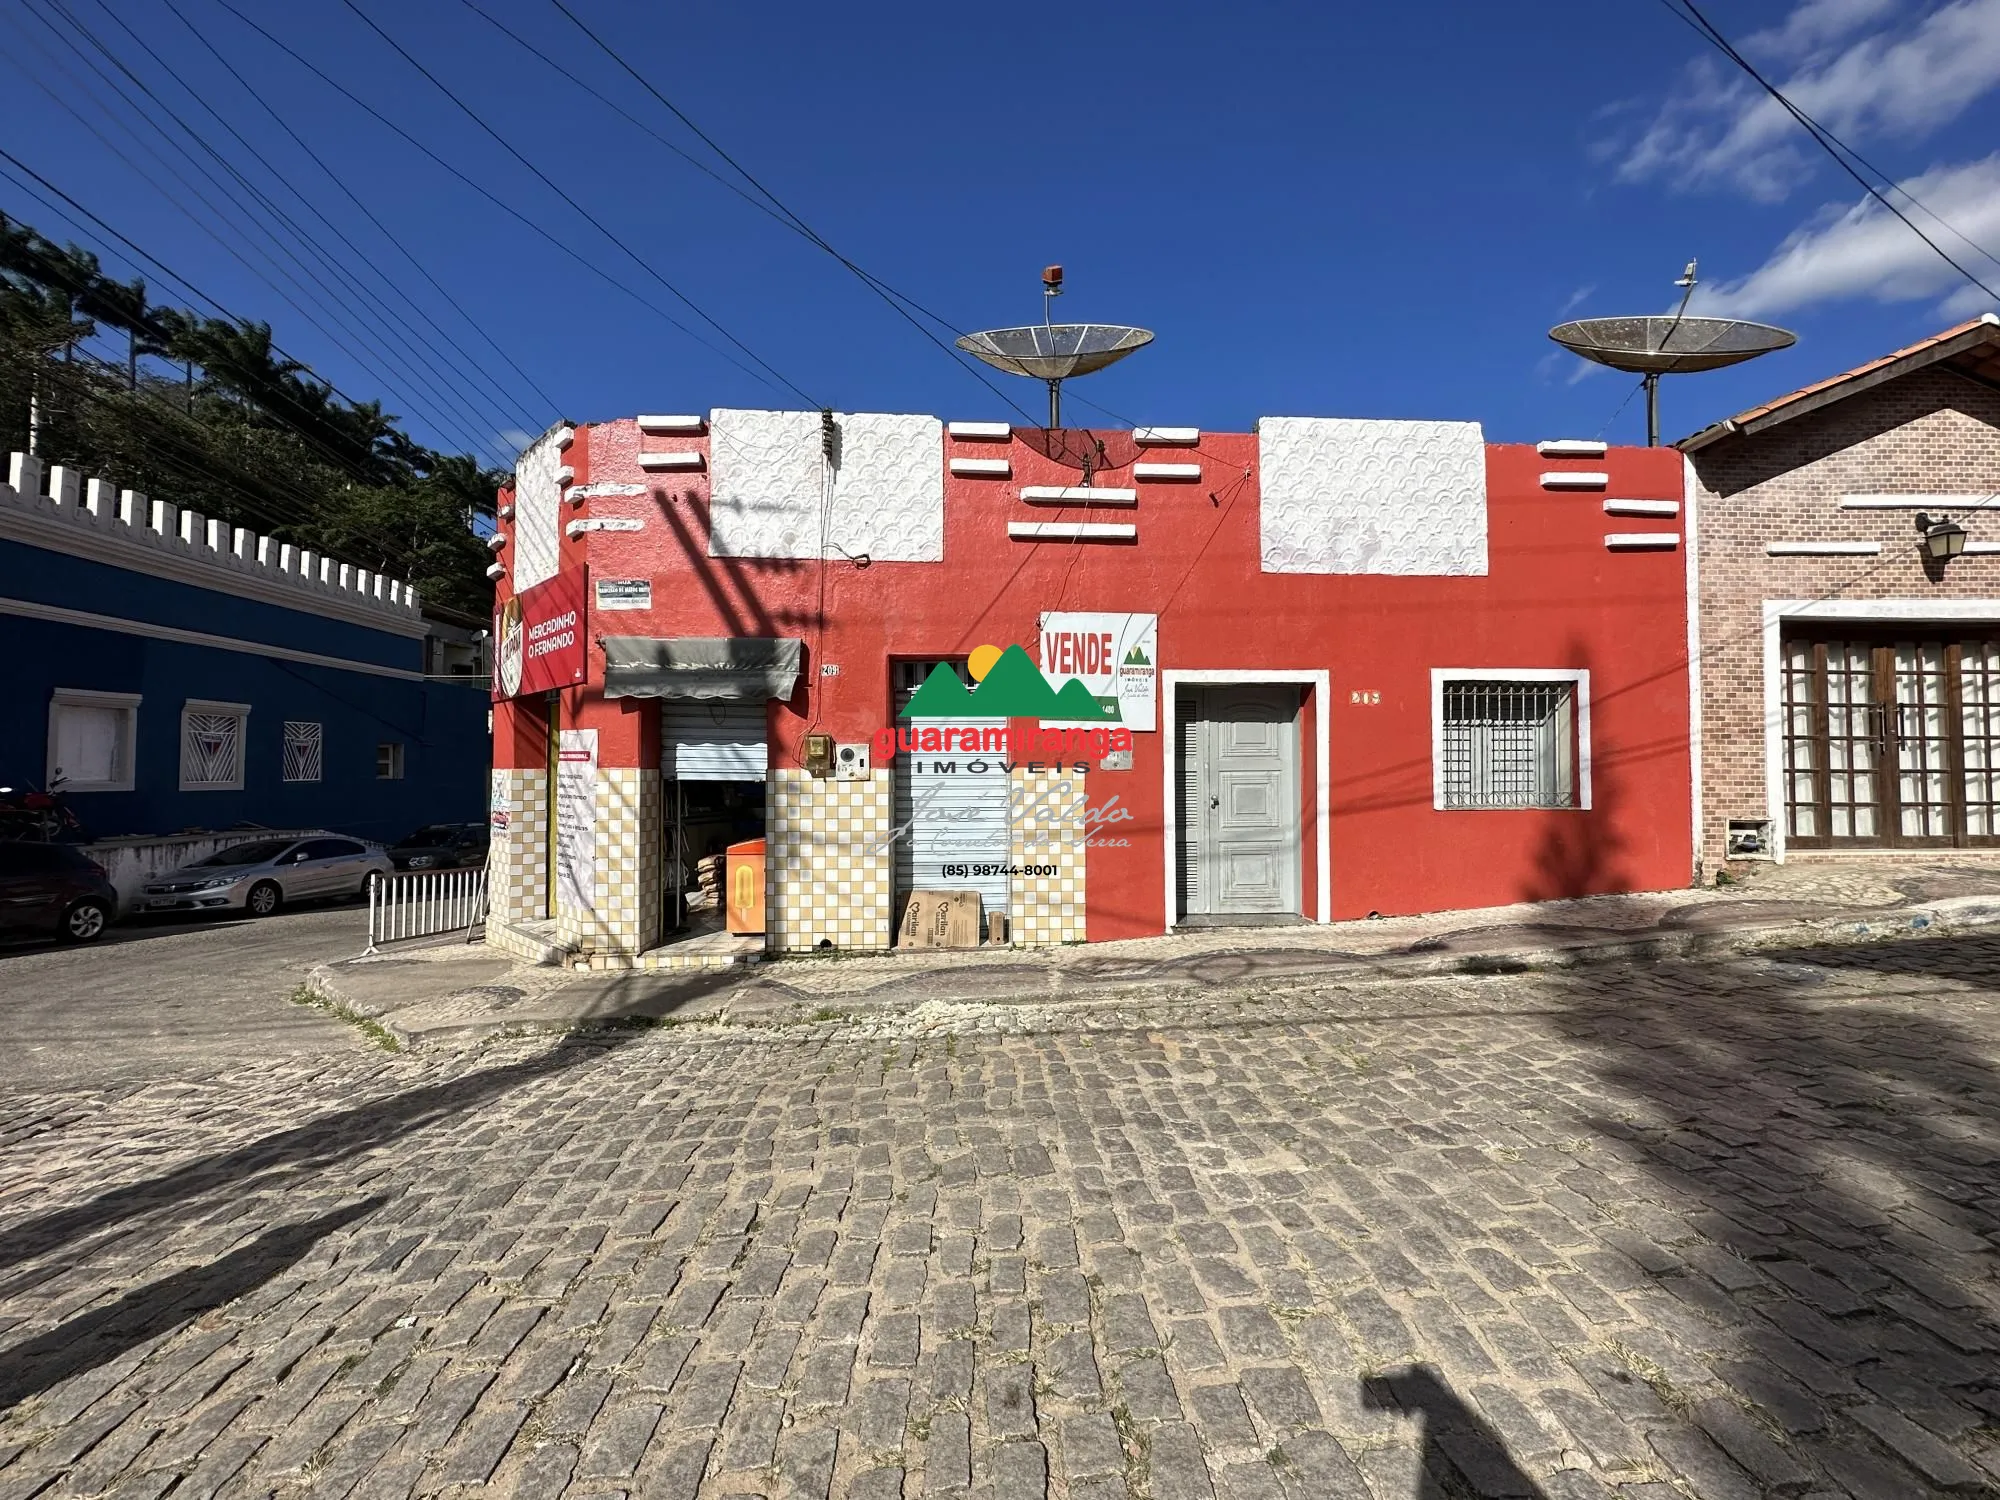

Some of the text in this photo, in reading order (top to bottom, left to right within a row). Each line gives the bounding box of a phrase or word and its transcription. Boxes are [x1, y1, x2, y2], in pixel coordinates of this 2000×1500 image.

[528, 610, 576, 642] MERCADINHO
[528, 645, 534, 658] O
[534, 631, 575, 656] FERNANDO
[1045, 632, 1112, 675] VENDE
[1119, 667, 1155, 677] guaramiranga
